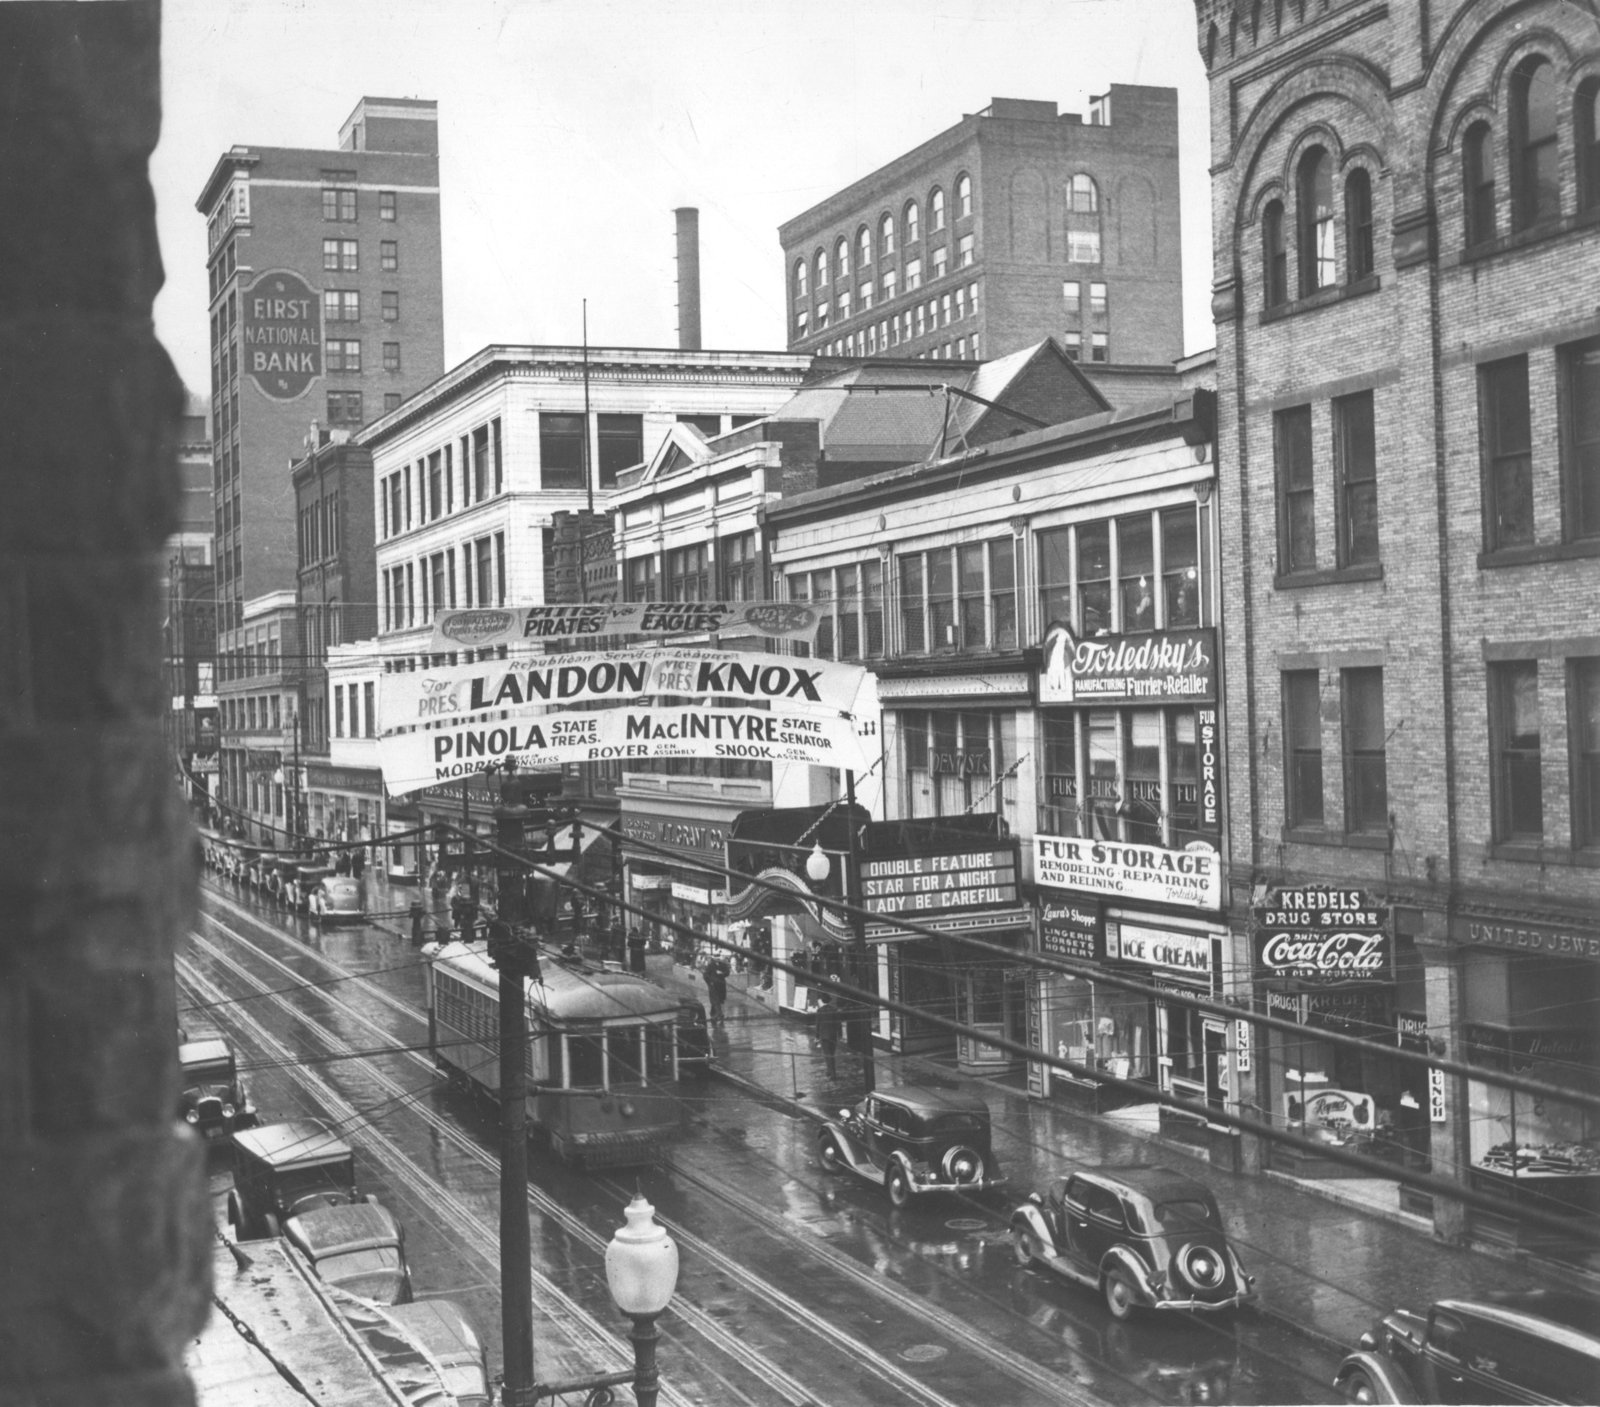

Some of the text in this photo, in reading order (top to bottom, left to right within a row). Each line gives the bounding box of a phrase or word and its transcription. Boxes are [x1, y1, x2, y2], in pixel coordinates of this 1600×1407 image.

[253, 299, 310, 319] FIRST
[245, 326, 319, 345] NATIONAL
[253, 351, 314, 372] BANK
[523, 616, 601, 638] PIRATES
[640, 614, 722, 632] EAGLES
[509, 655, 592, 671] Republican
[665, 660, 693, 670] VICE
[421, 678, 451, 694] For
[470, 661, 647, 710] LANDON
[696, 661, 824, 702] KNOX
[1075, 678, 1125, 692] MANUFACTURING
[1127, 677, 1163, 696] Furrier
[1167, 674, 1208, 695] Retailer
[551, 719, 598, 734] STATE
[782, 718, 822, 733] STATE
[1200, 711, 1215, 724] FUR
[626, 713, 779, 743] MacINTYRE
[434, 724, 547, 763] PINOLA
[550, 733, 601, 747] TREAS.
[780, 732, 832, 749] SENATOR
[588, 744, 649, 759] BOYER
[653, 748, 697, 756] ASSEMBLY
[715, 743, 776, 759] SNOOK
[435, 758, 501, 780] MORRIS
[515, 755, 559, 766] ONGRESS
[1202, 726, 1216, 822] STORAGE
[870, 852, 994, 877] DOUBLE FEATURE
[1039, 840, 1211, 875] FUR STORAGE
[866, 870, 997, 896] STAR FOR A NIGHT
[1040, 860, 1210, 890] REMODELING REPAIRING
[1041, 871, 1065, 882] AND
[866, 888, 1003, 913] LADY BE CAREFUL
[1281, 892, 1360, 910] KREDELS
[1071, 908, 1096, 927] Shoppe
[1266, 912, 1377, 925] DRUG STORE
[1044, 928, 1094, 942] LINGERIE
[1045, 935, 1095, 950] CORSETS
[1469, 923, 1542, 948] UNITED
[1045, 944, 1095, 958] HOSIERY
[1123, 939, 1146, 960] ICE
[1153, 944, 1208, 970] CREAM
[1269, 993, 1298, 1011] DRUGS
